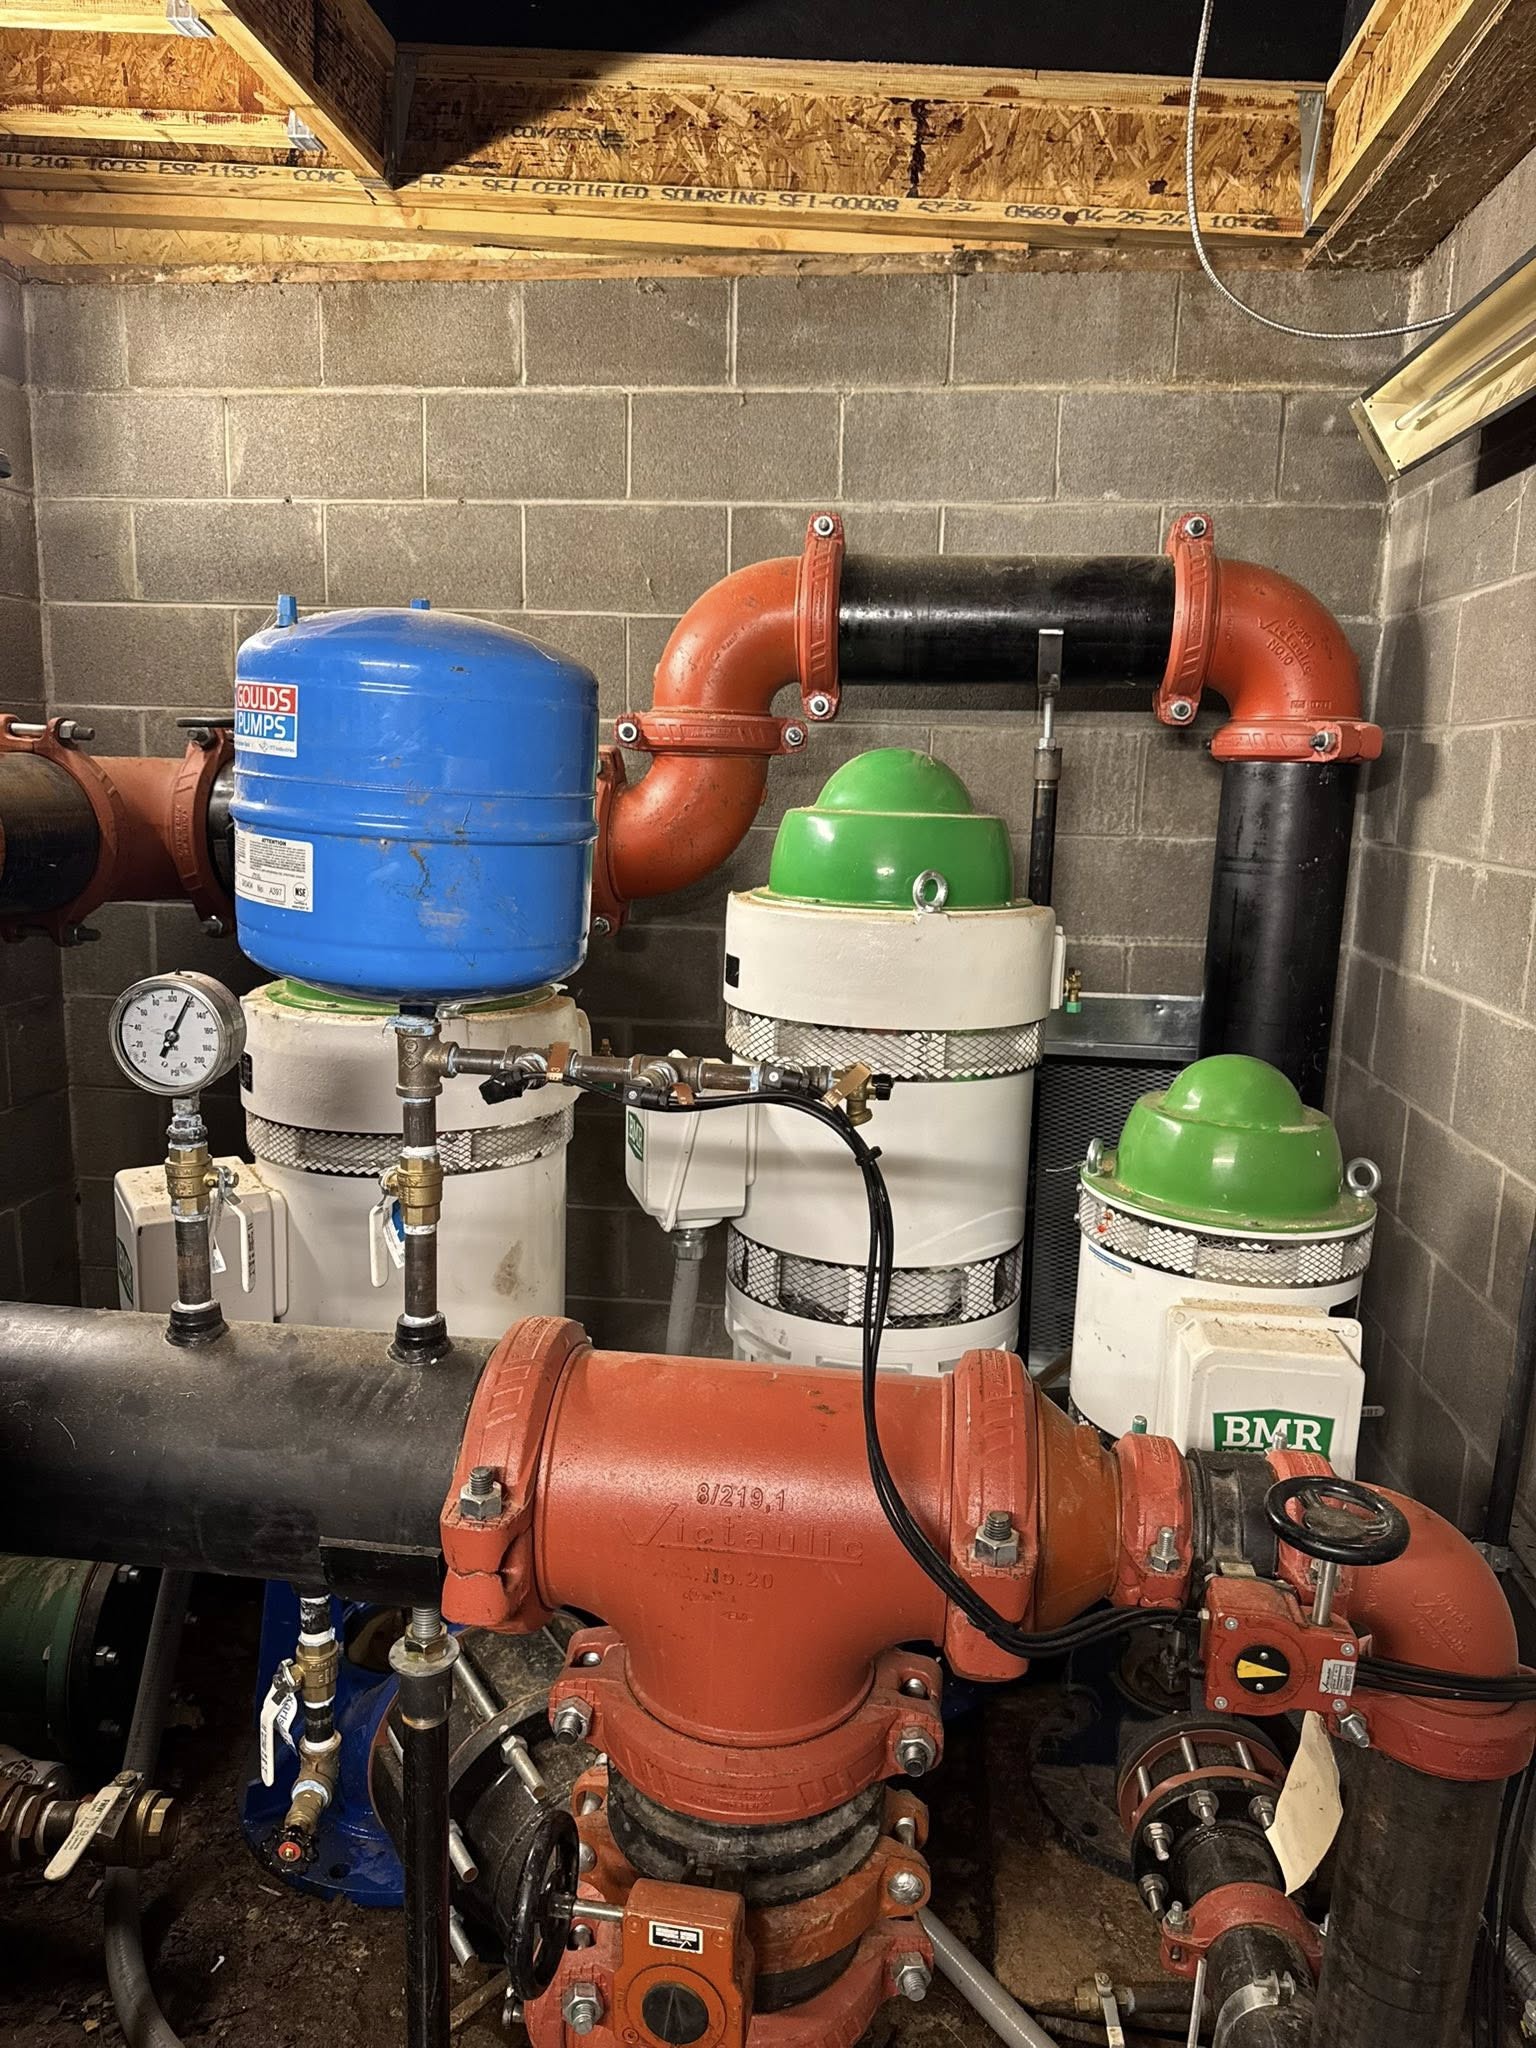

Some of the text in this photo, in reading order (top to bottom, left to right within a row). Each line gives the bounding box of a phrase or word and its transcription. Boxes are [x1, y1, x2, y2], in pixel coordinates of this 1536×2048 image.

[532, 181, 649, 199] CERTIFIED
[660, 187, 767, 206] SOURCING
[237, 685, 292, 711] GOULDS
[238, 711, 287, 739] PUMPS
[1222, 1415, 1322, 1451] BMR
[696, 1482, 786, 1513] 8/219,1
